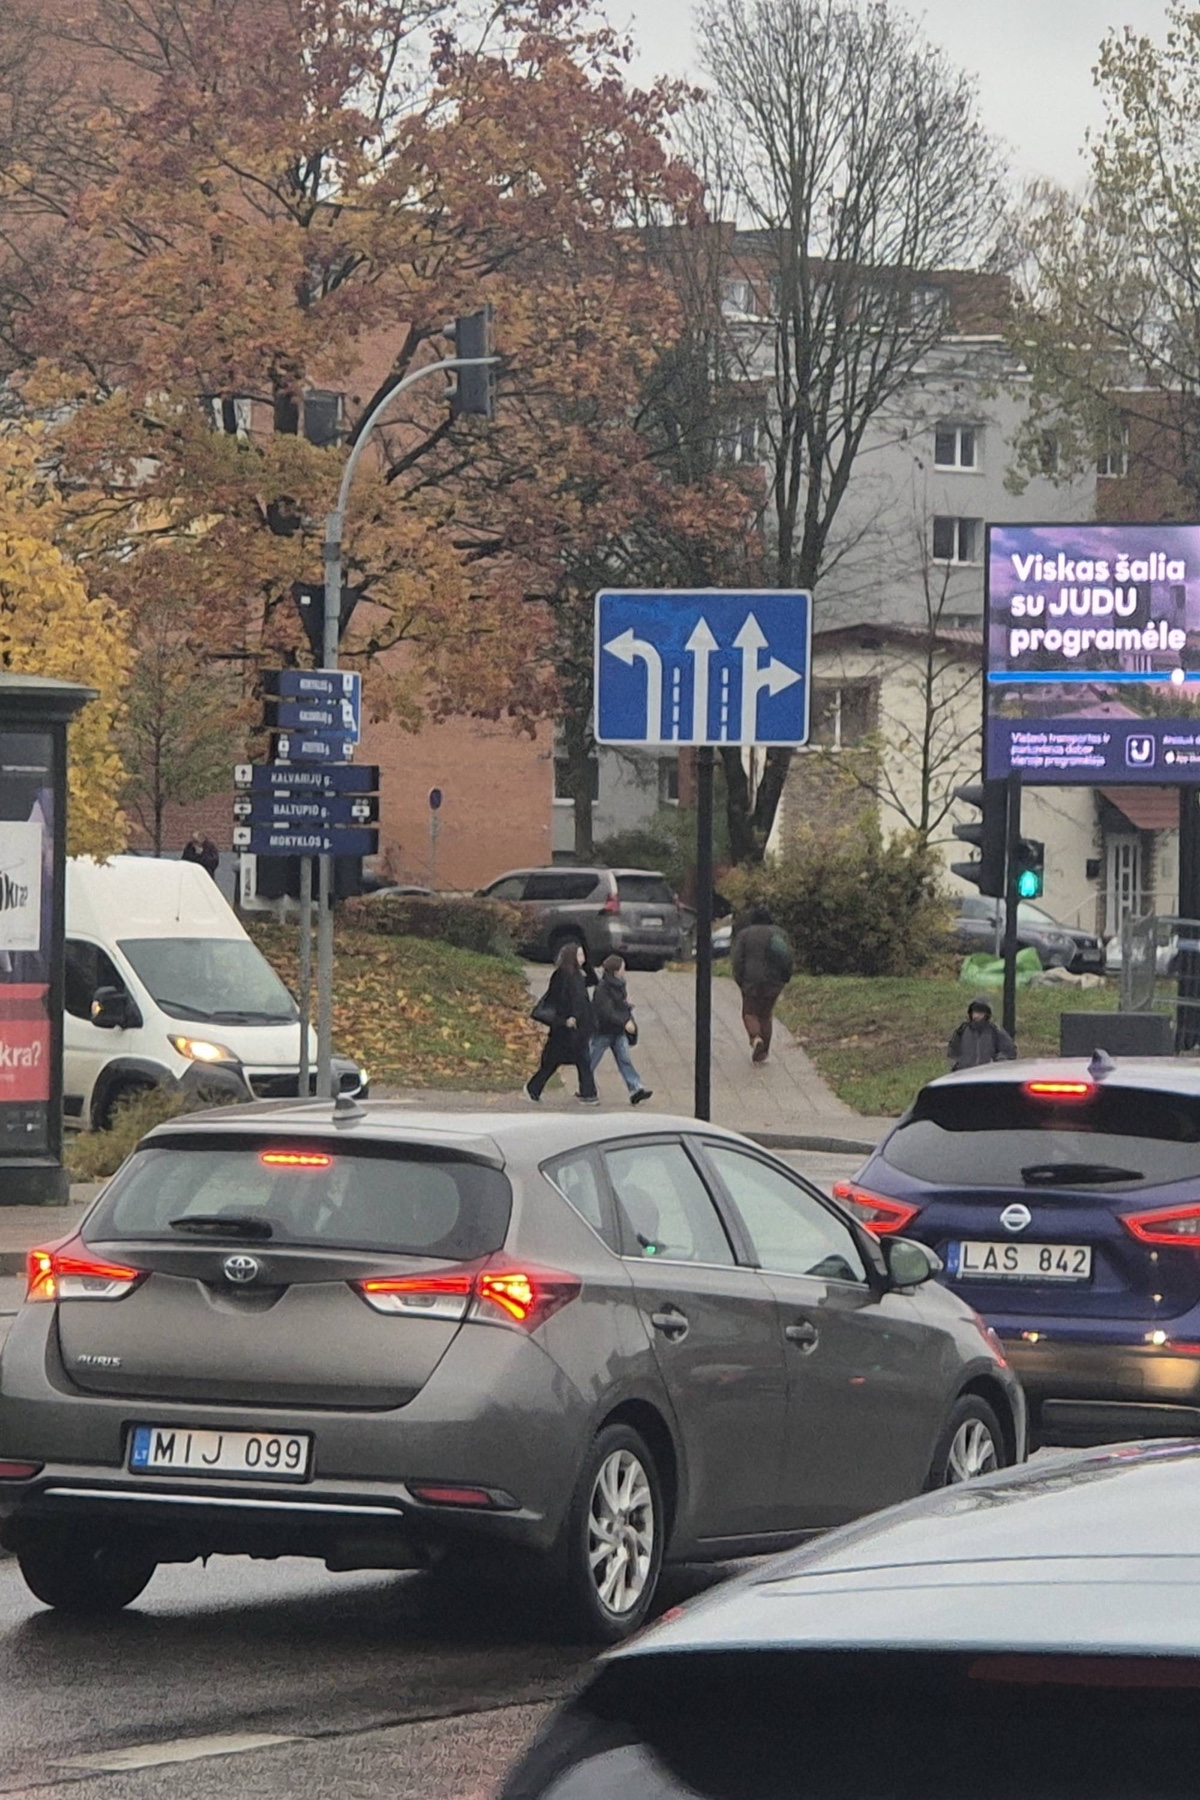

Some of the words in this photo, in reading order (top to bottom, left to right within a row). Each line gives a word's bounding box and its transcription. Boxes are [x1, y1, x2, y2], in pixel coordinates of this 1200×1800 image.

[1011, 552, 1110, 582] Viskas
[1115, 552, 1186, 582] šalia
[1011, 594, 1045, 617] su
[1050, 587, 1137, 617] JUDU
[1010, 620, 1187, 658] programėle
[269, 835, 321, 848] MOKYKLOS
[963, 1245, 1019, 1271] LAS
[1039, 1248, 1087, 1274] 842
[153, 1432, 223, 1465] MIJ
[245, 1437, 302, 1469] 099
